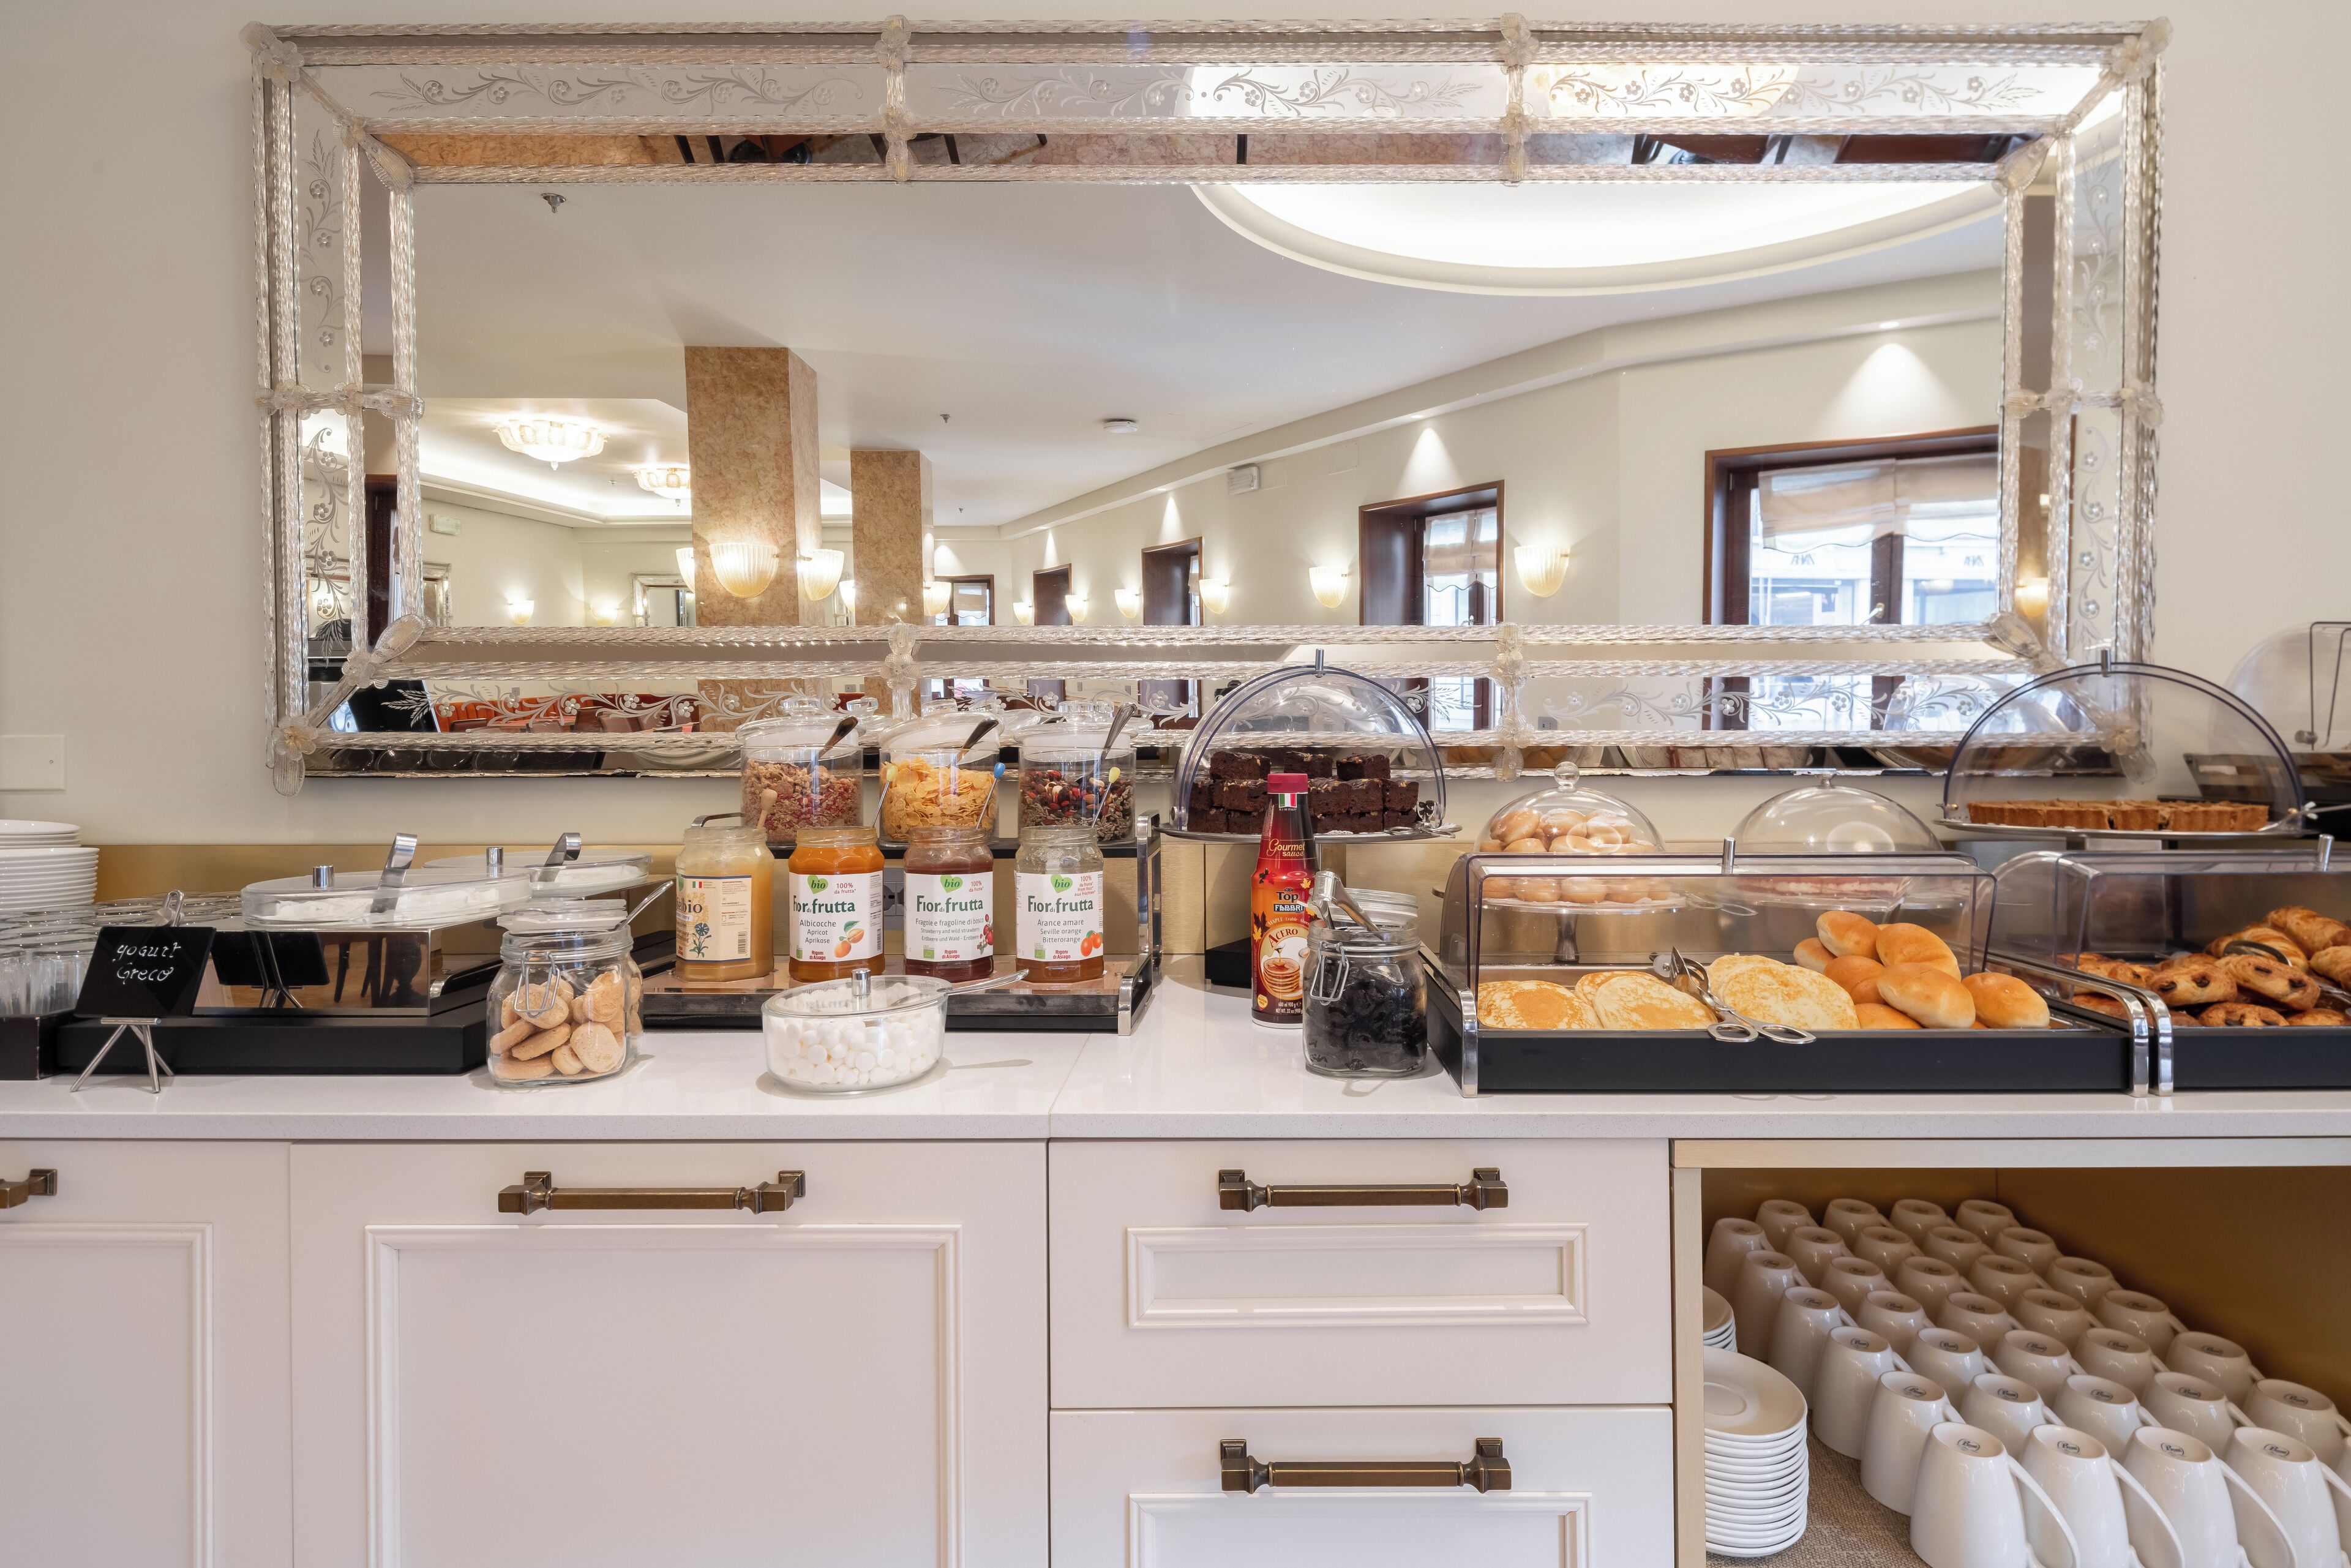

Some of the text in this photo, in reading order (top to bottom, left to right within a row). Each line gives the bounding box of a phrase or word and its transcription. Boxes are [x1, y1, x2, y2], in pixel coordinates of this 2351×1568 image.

[1266, 838, 1305, 857] Gourmet
[811, 880, 826, 889] bio
[944, 879, 960, 888] bio
[1054, 879, 1070, 888] bio
[1276, 891, 1299, 903] Top
[812, 898, 855, 913] frutta
[917, 895, 941, 912] Fior
[945, 897, 983, 913] frutta
[1028, 895, 1052, 912] Fior
[1056, 898, 1093, 913] frutta
[915, 918, 933, 927] Fragole
[116, 962, 174, 985] Greco
